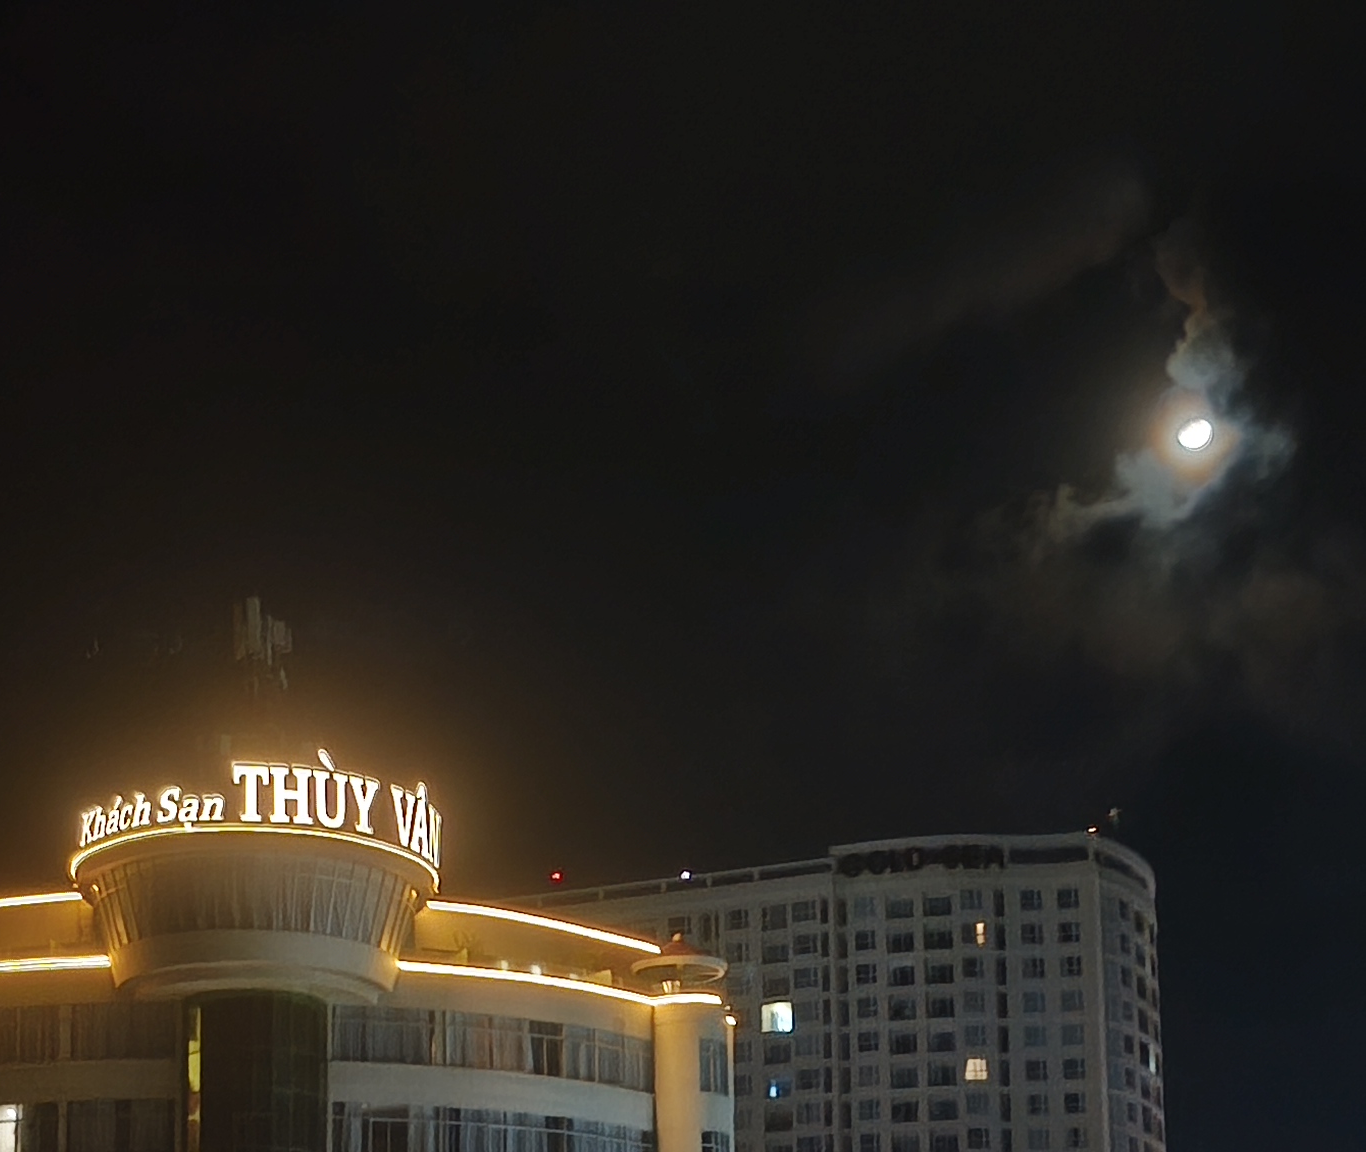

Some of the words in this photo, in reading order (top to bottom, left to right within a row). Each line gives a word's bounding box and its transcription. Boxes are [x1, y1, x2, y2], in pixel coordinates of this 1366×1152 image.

[79, 792, 151, 848] Khách
[157, 786, 225, 831] Sạn
[232, 749, 381, 835] THÙY
[390, 781, 442, 868] VÂN
